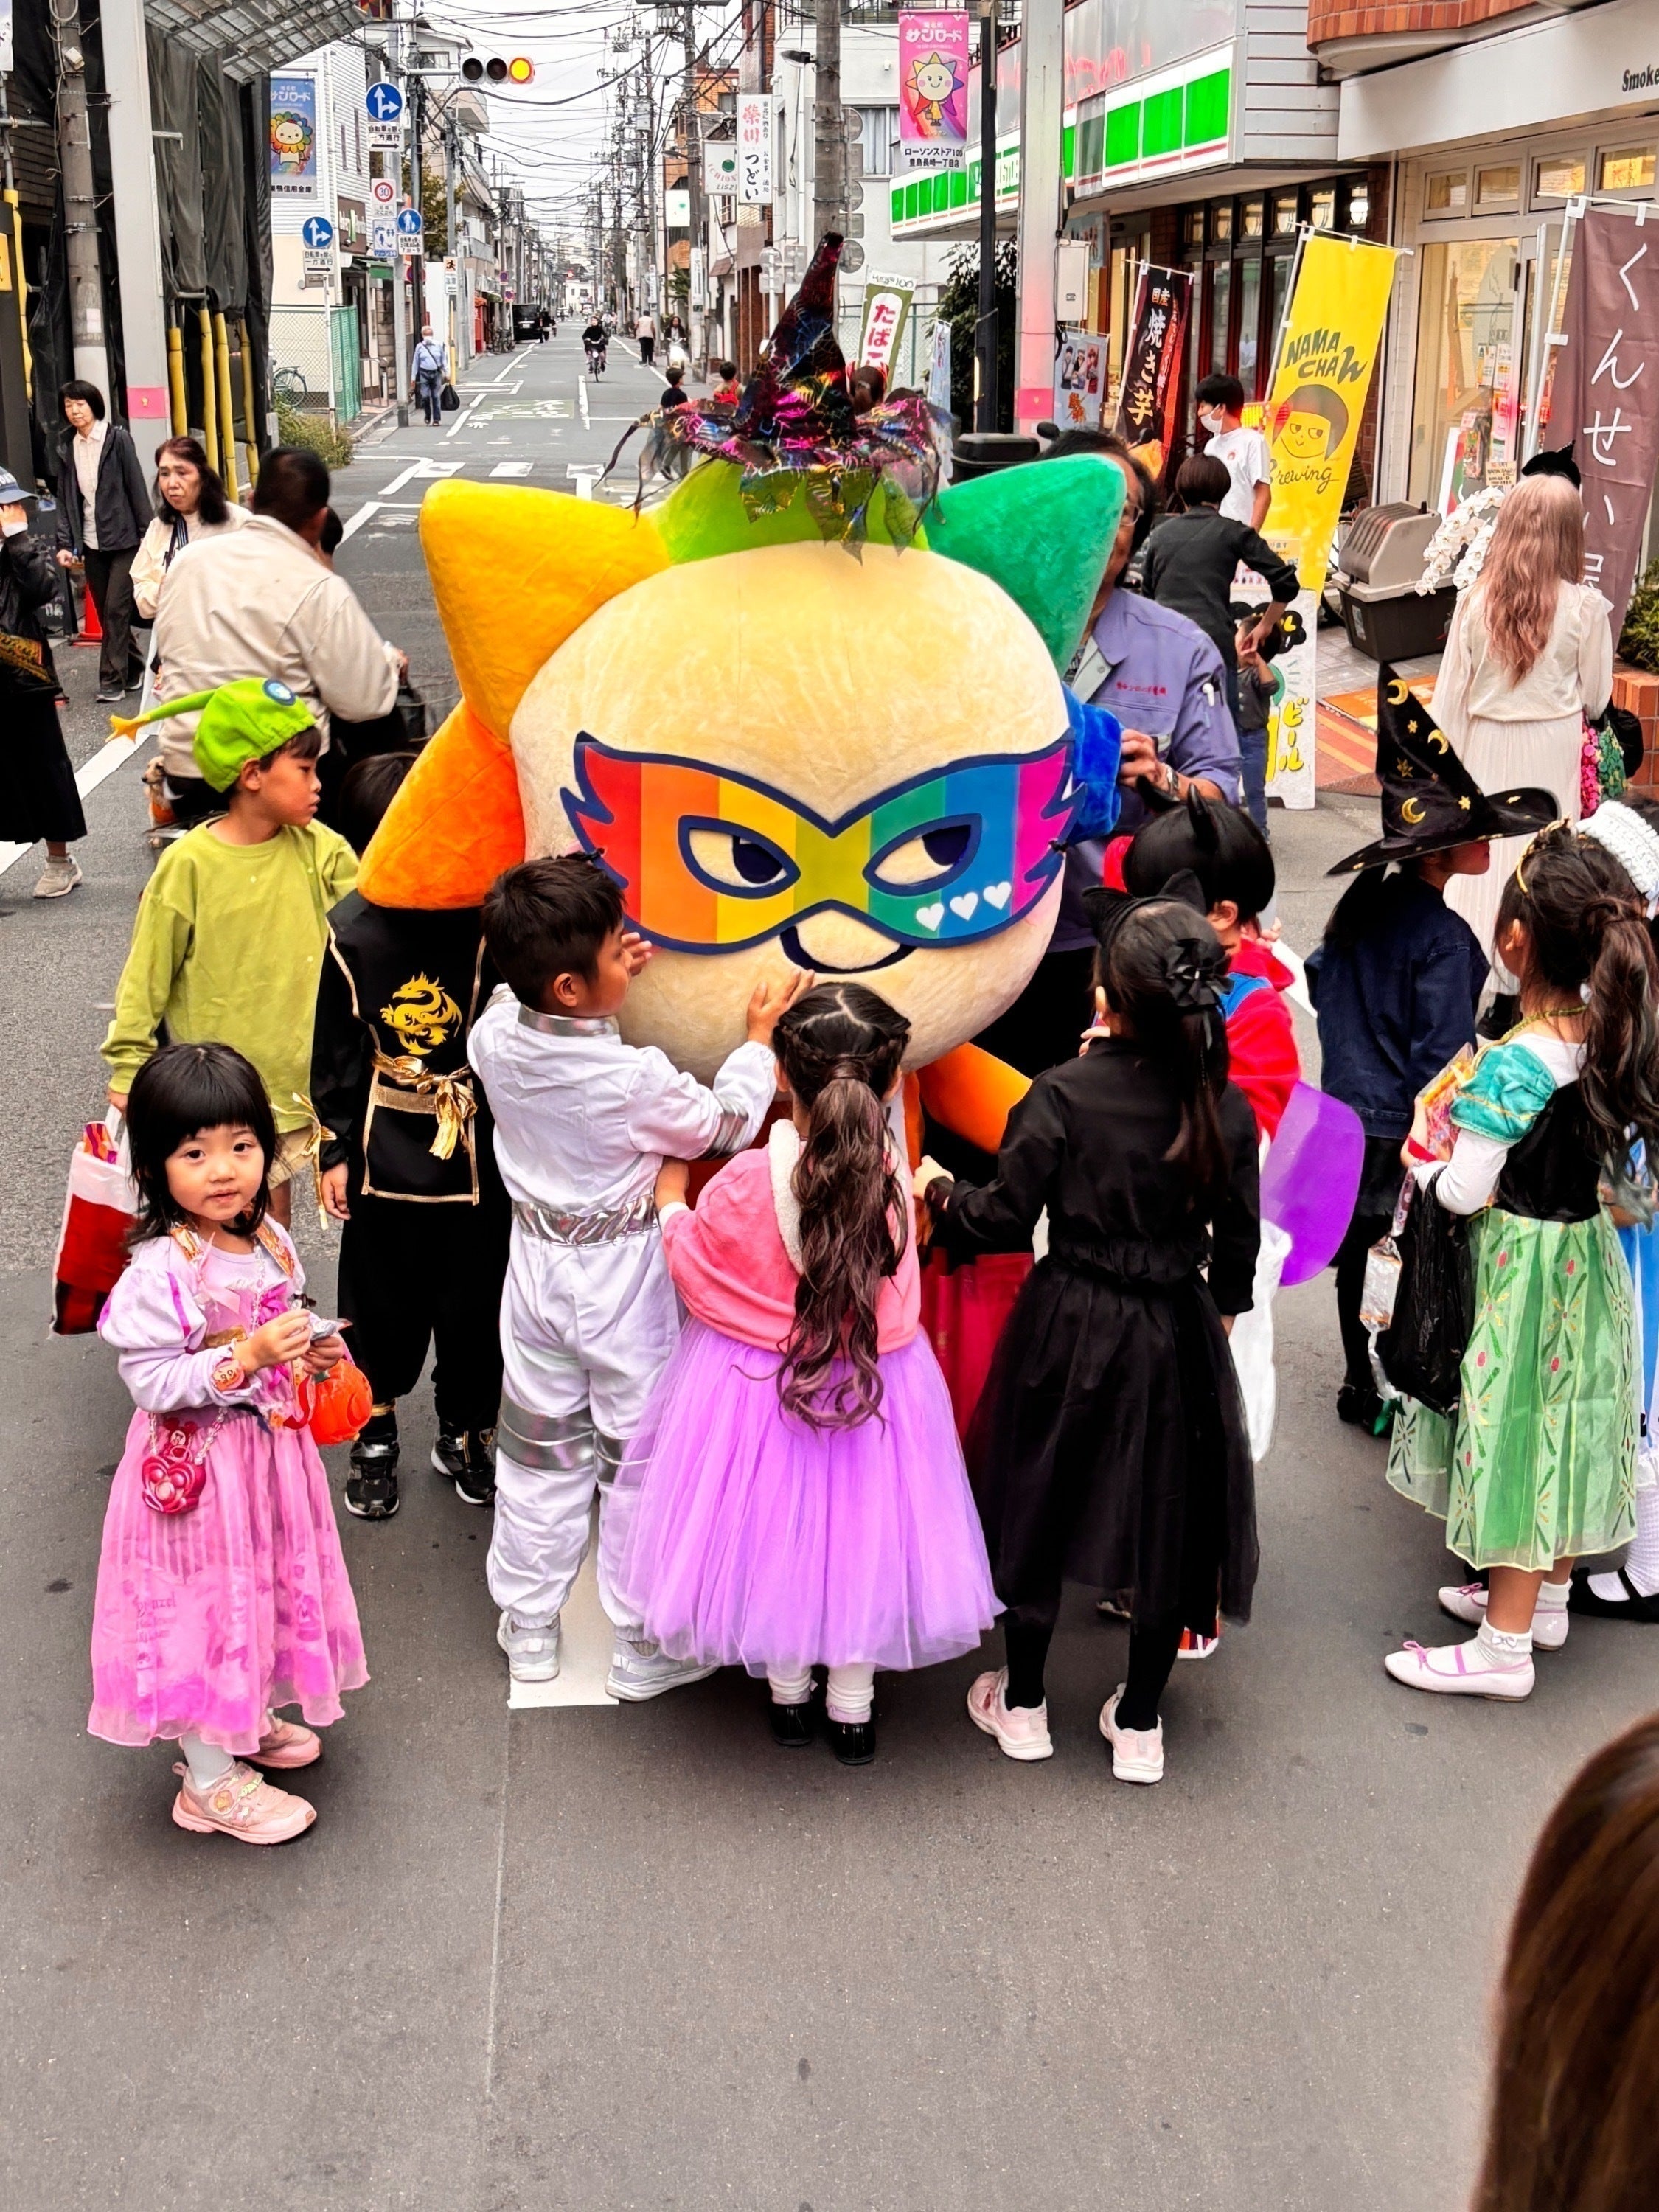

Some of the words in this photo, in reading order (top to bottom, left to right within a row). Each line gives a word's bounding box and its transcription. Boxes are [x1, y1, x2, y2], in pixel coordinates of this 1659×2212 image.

[905, 29, 963, 43] サンロード
[905, 148, 963, 157] ローソンストア100
[379, 187, 389, 197] 30
[745, 154, 759, 201] つどい
[1152, 287, 1171, 306] 国産
[1284, 327, 1341, 369] NAMA
[1127, 307, 1166, 426] 焼き芋
[1279, 695, 1309, 772] ビール
